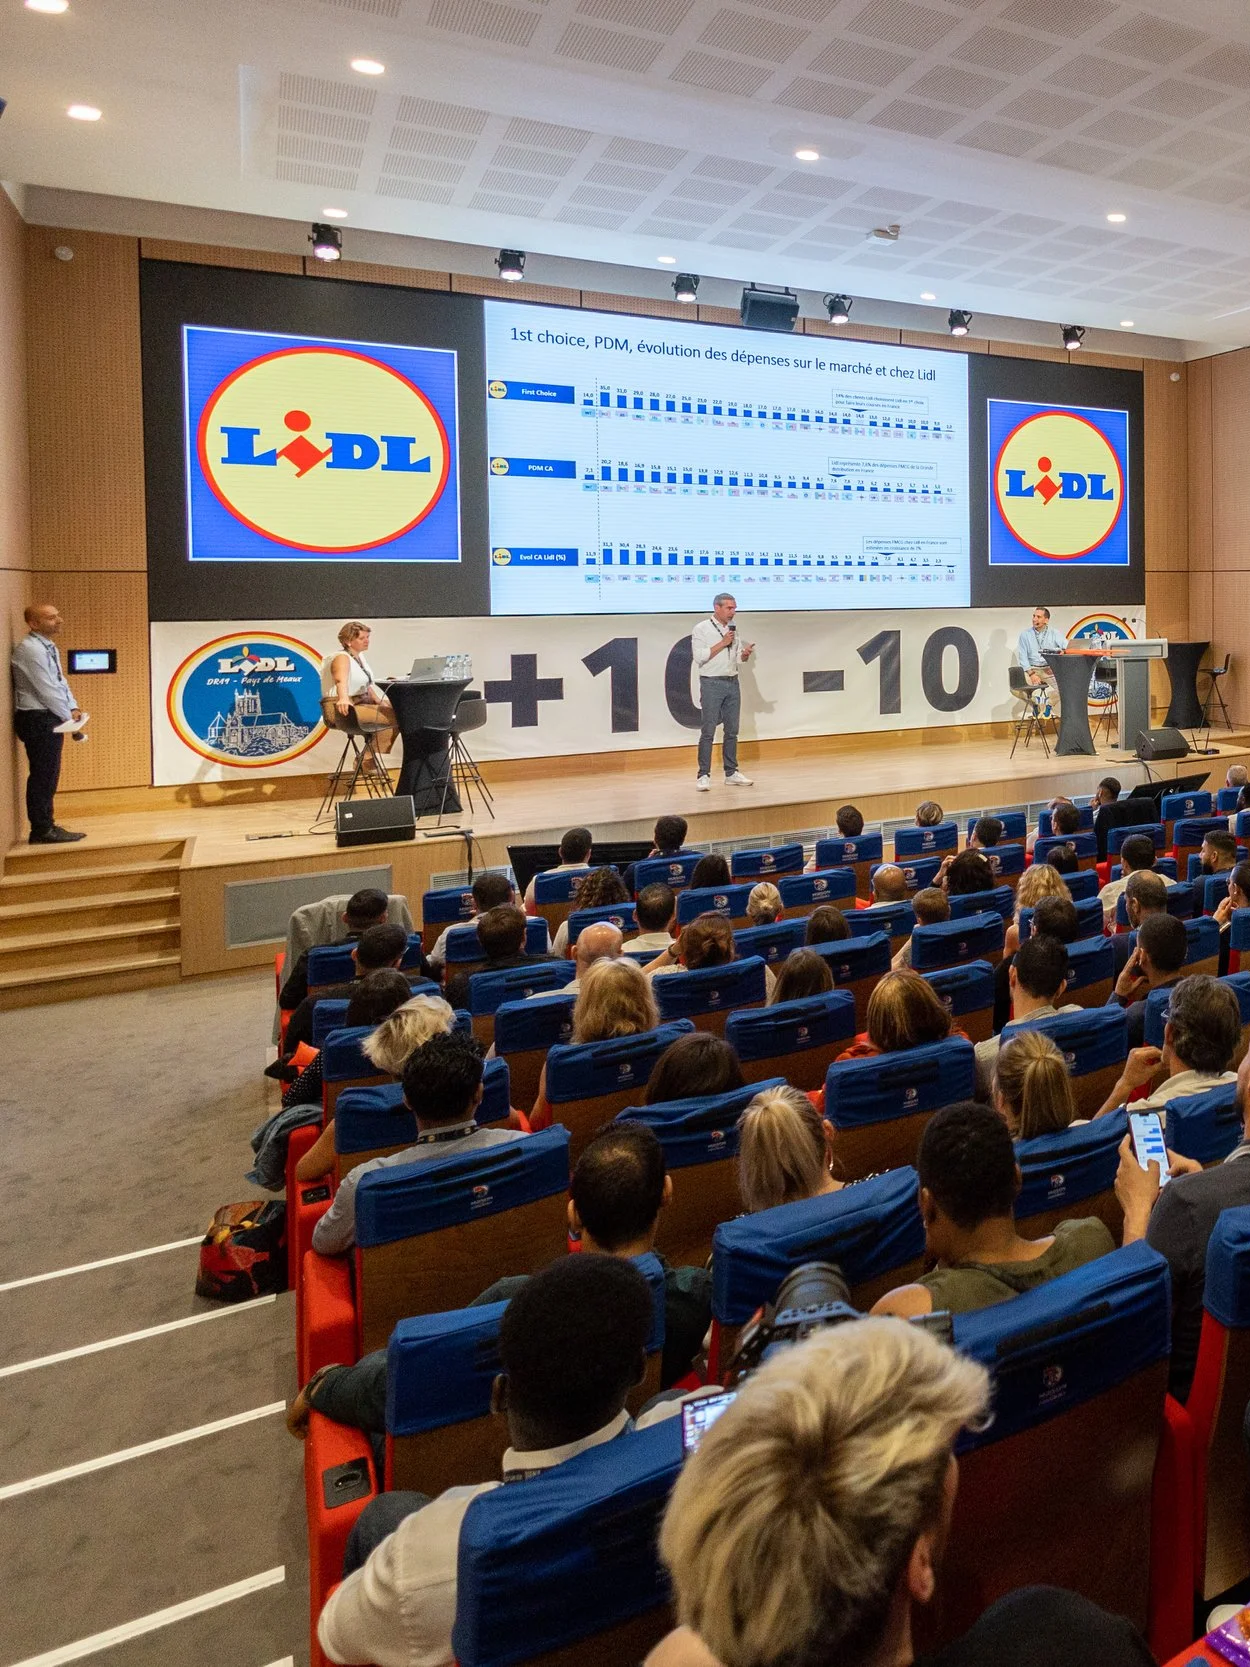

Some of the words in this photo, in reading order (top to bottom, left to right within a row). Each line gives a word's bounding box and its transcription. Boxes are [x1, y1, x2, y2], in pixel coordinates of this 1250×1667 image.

[510, 327, 533, 342] 1st
[537, 330, 589, 350] choice,
[595, 336, 632, 354] PDM,
[637, 340, 700, 359] évolution
[704, 347, 728, 361] des
[731, 349, 791, 367] dépenses
[793, 359, 812, 369] sur
[816, 358, 826, 371] le
[829, 362, 872, 375] marché
[876, 366, 887, 376] et
[890, 366, 914, 380] chez
[918, 369, 936, 381] Lidl
[536, 389, 557, 397] Choice
[241, 677, 261, 686] Pays
